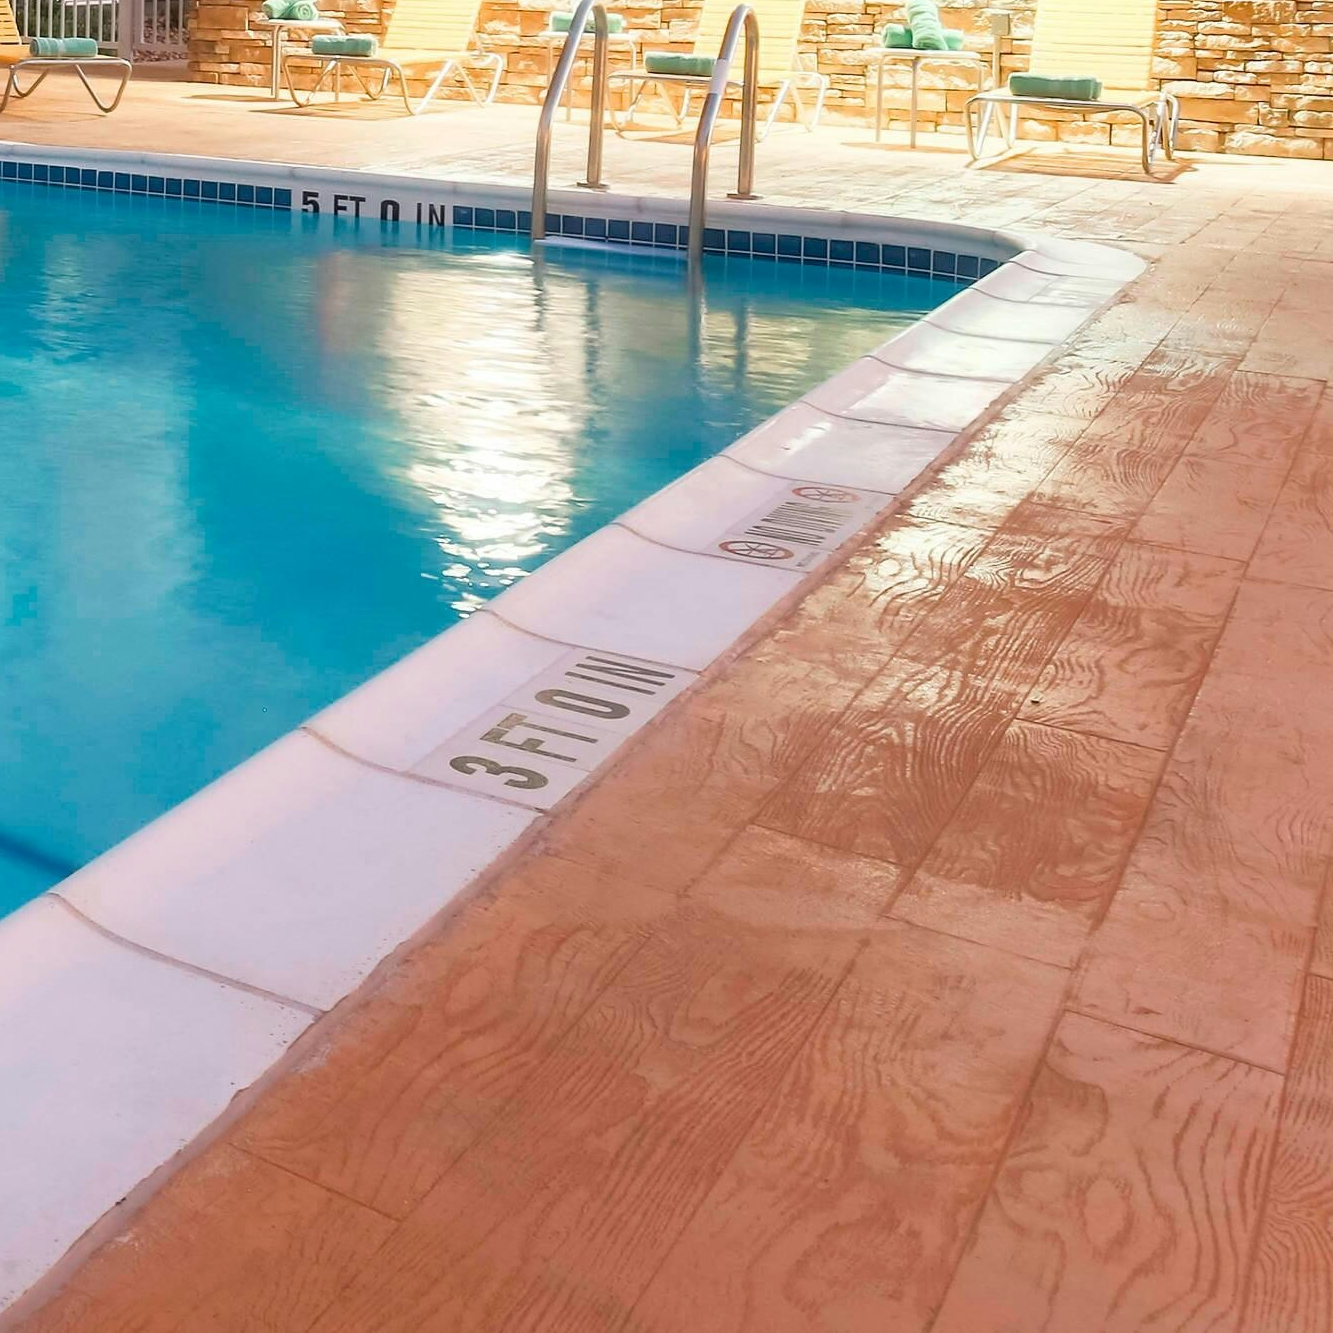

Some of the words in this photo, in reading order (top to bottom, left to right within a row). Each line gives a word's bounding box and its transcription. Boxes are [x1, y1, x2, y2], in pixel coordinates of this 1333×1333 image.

[302, 191, 320, 213] 5
[334, 194, 366, 218] FT
[416, 202, 445, 226] IN
[564, 655, 675, 696] IN
[480, 713, 598, 763] FT
[449, 755, 549, 790] 3
